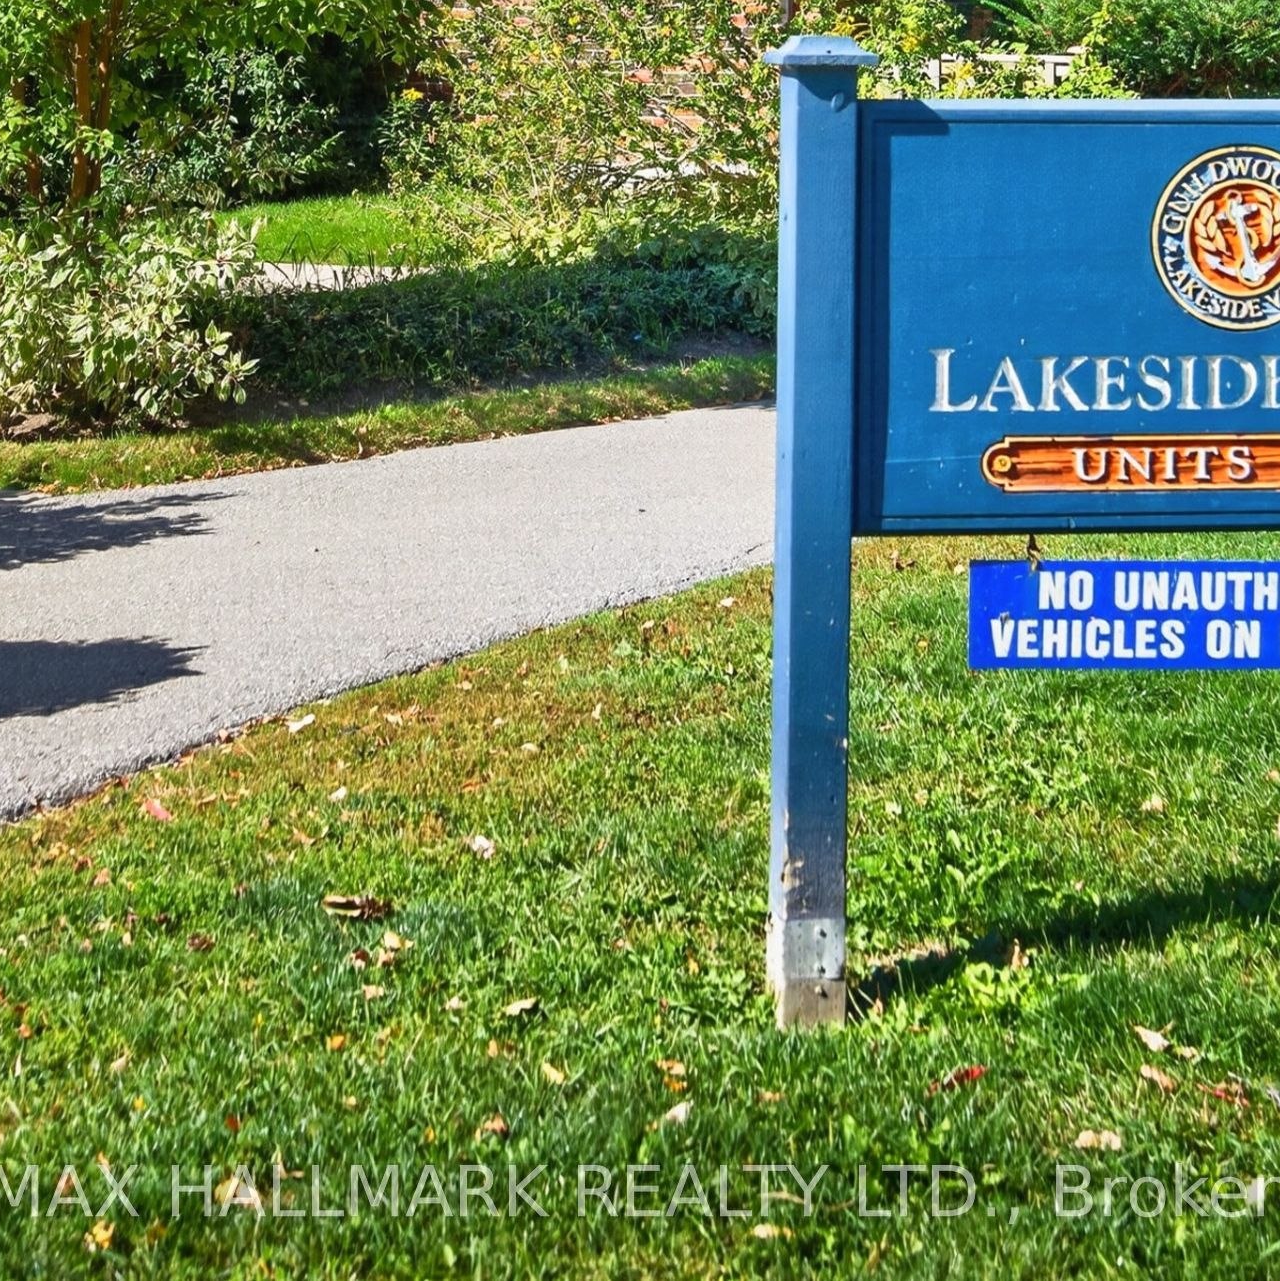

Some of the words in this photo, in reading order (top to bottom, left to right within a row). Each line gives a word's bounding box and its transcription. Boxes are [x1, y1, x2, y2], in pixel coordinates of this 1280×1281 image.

[1162, 249, 1265, 319] LAKESIDE
[1072, 446, 1251, 482] UNITS
[1037, 569, 1094, 611] NO
[990, 618, 1186, 659] VEHICLES
[1206, 617, 1261, 659] ON
